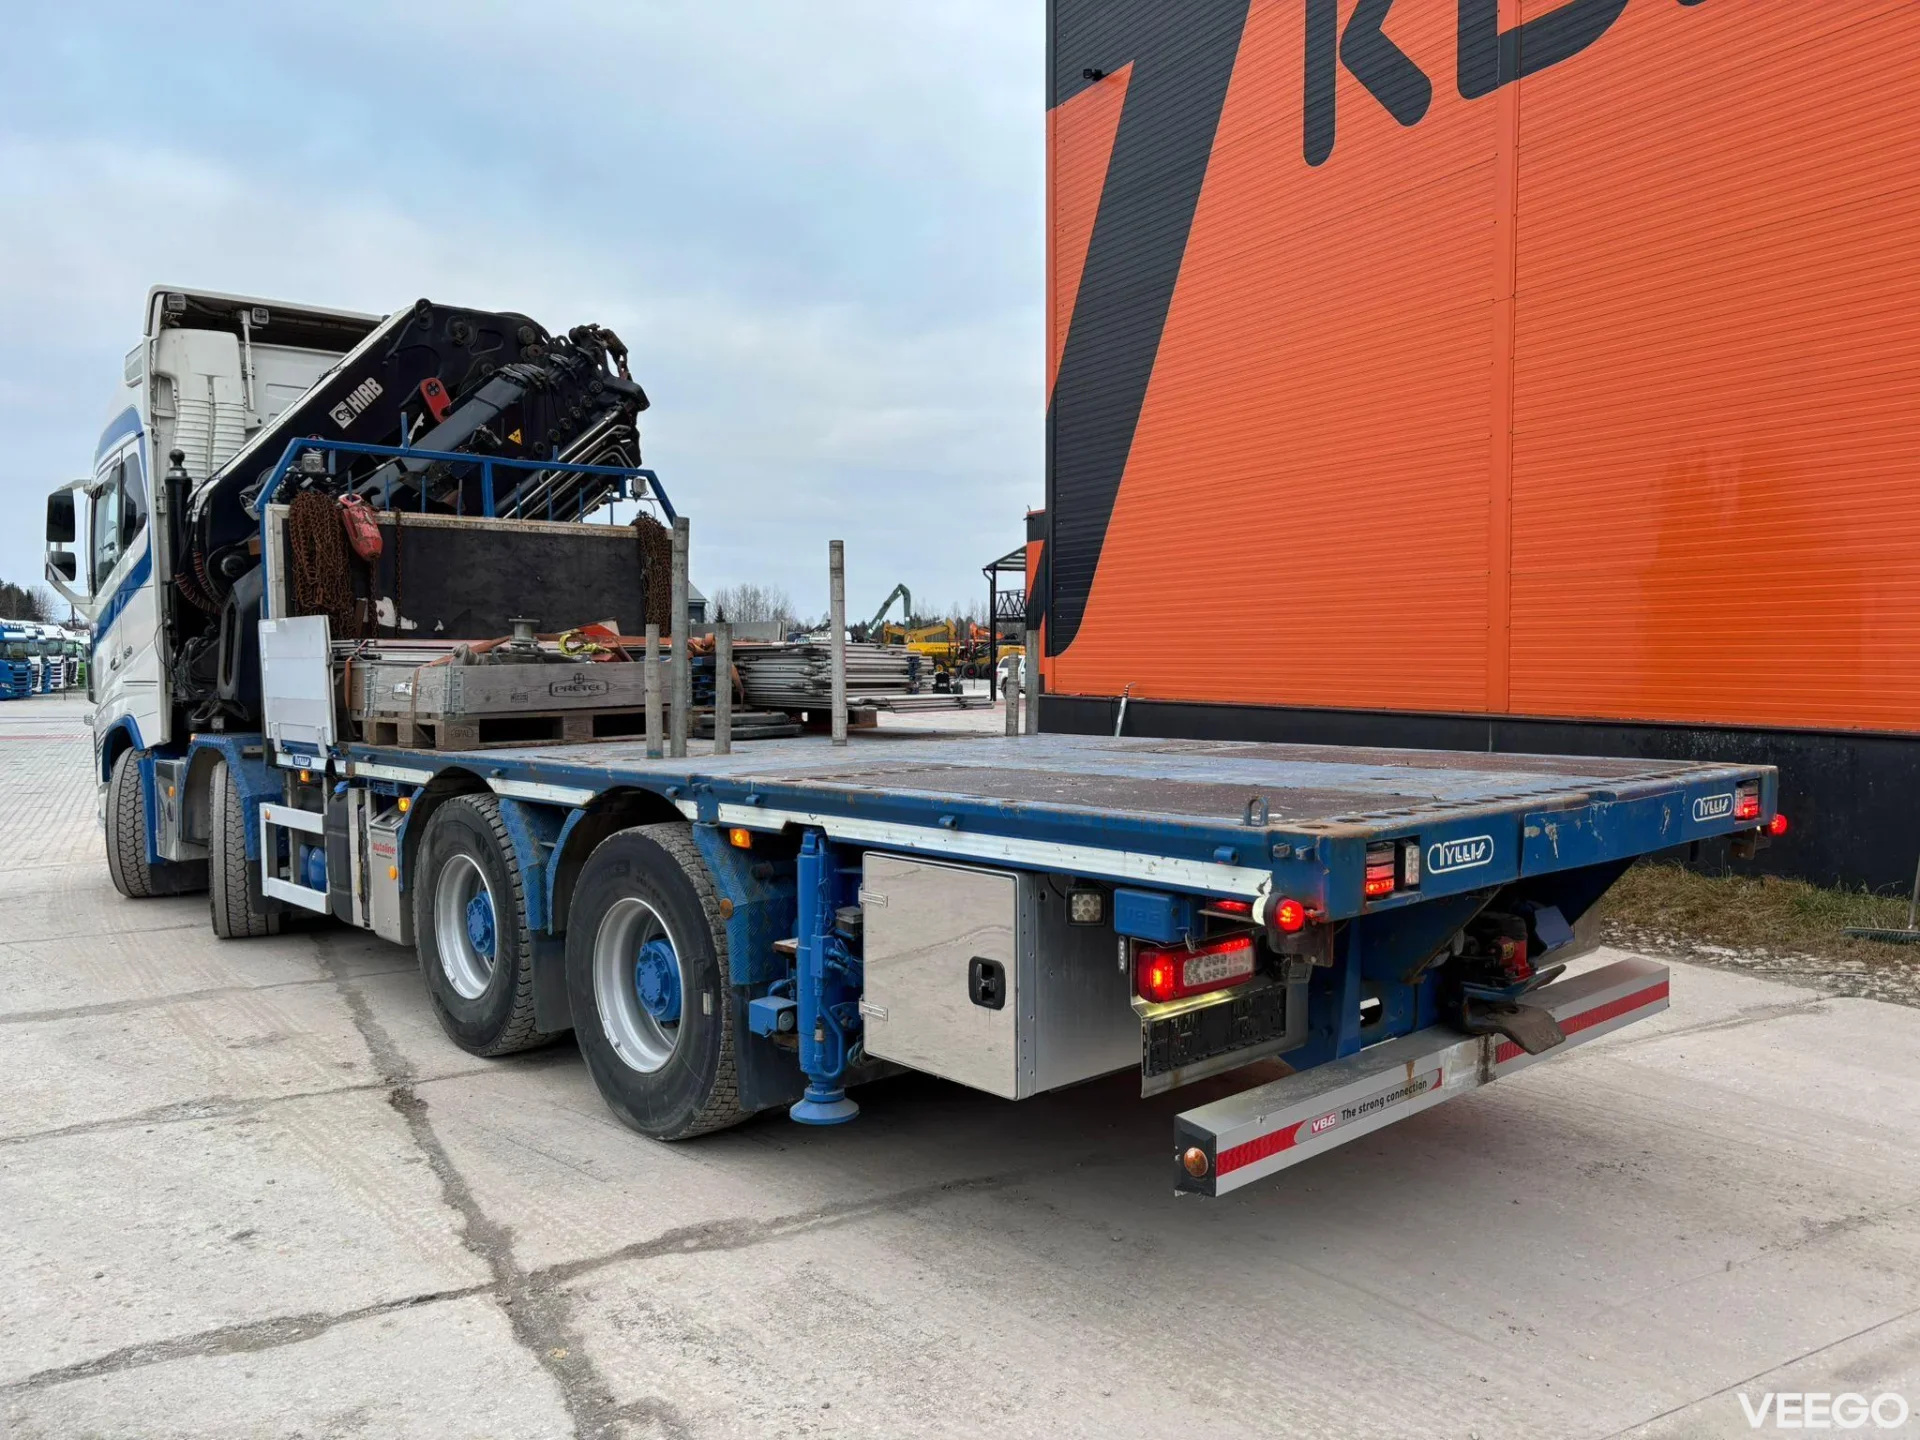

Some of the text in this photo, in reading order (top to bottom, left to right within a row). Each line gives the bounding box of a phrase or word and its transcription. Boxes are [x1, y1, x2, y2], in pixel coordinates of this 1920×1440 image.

[346, 377, 383, 413] HIAB
[1695, 798, 1729, 816] TYLLIS
[1434, 841, 1486, 866] TYLLIS
[1312, 1080, 1427, 1132] VBG The strong connection
